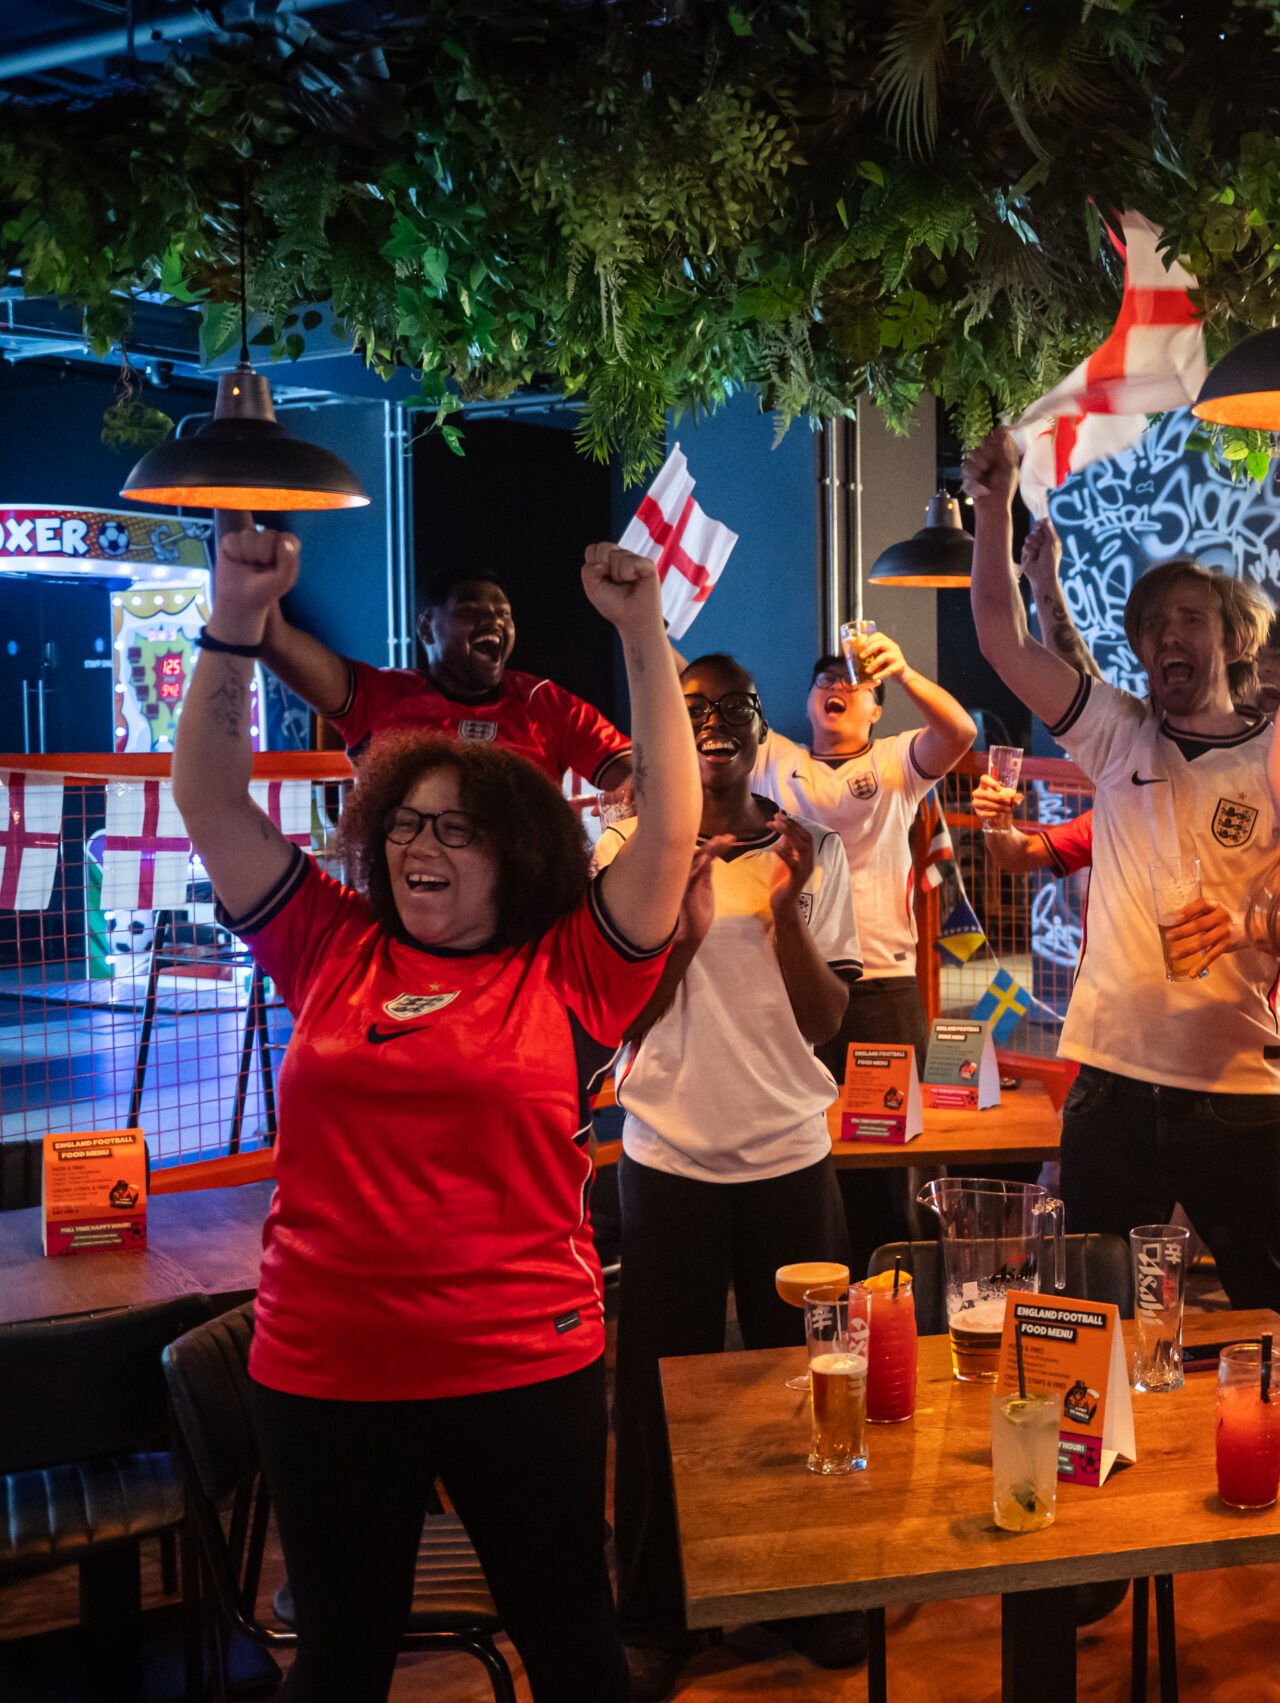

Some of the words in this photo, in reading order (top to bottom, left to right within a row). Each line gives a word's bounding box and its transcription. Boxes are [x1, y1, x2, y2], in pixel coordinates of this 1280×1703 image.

[0, 517, 90, 557] XER
[162, 658, 182, 676] 125
[54, 1140, 92, 1150] ENGLAND
[93, 1136, 134, 1146] FOOTBALL
[61, 1150, 85, 1159] FOOD
[86, 1149, 110, 1157] MENU
[1137, 1252, 1166, 1326] Asahi
[1016, 1306, 1057, 1319] ENGLAND
[1057, 1311, 1103, 1325] FOOTBALL
[1021, 1323, 1047, 1335] FOOD
[1047, 1327, 1074, 1339] MENU
[1062, 1441, 1085, 1452] HOUR!
